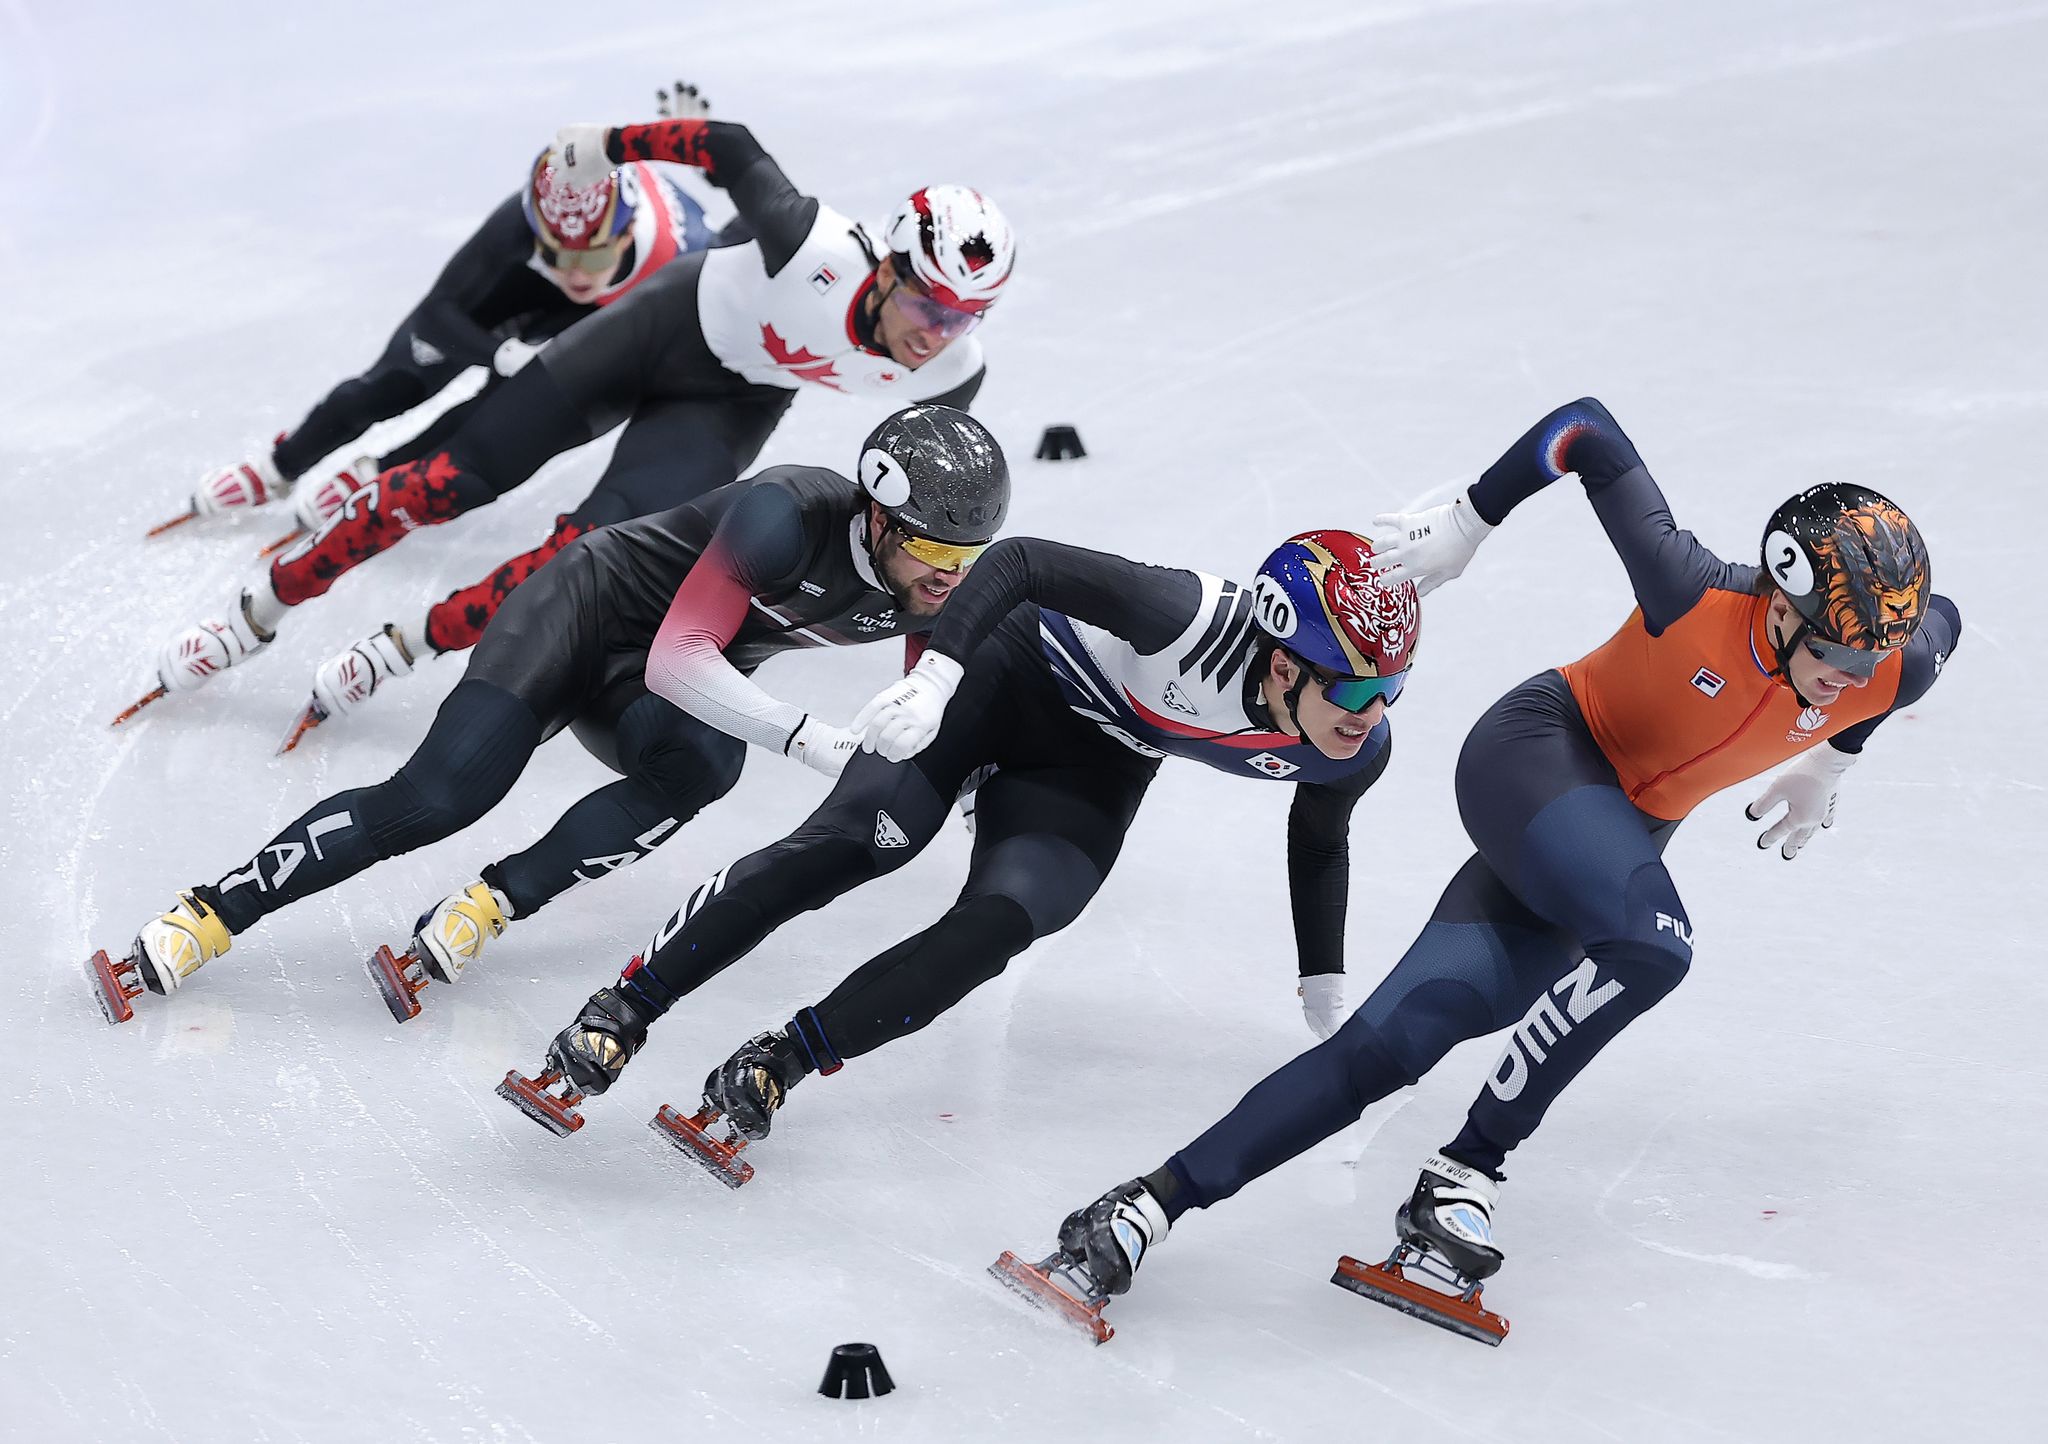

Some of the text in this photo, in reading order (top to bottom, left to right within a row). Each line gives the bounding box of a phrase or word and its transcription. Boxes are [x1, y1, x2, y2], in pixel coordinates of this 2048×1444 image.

[891, 213, 906, 235] 1
[873, 461, 890, 490] 7
[898, 511, 928, 530] NERPA
[1408, 525, 1432, 541] NED
[1774, 546, 1797, 582] 2
[1255, 582, 1289, 634] 110
[892, 688, 918, 706] KOREA
[833, 740, 858, 751] LATV
[217, 810, 354, 895] LAT
[1656, 912, 1694, 947] FIL
[1486, 957, 1626, 1102] NED
[1446, 1165, 1473, 1181] WOUT
